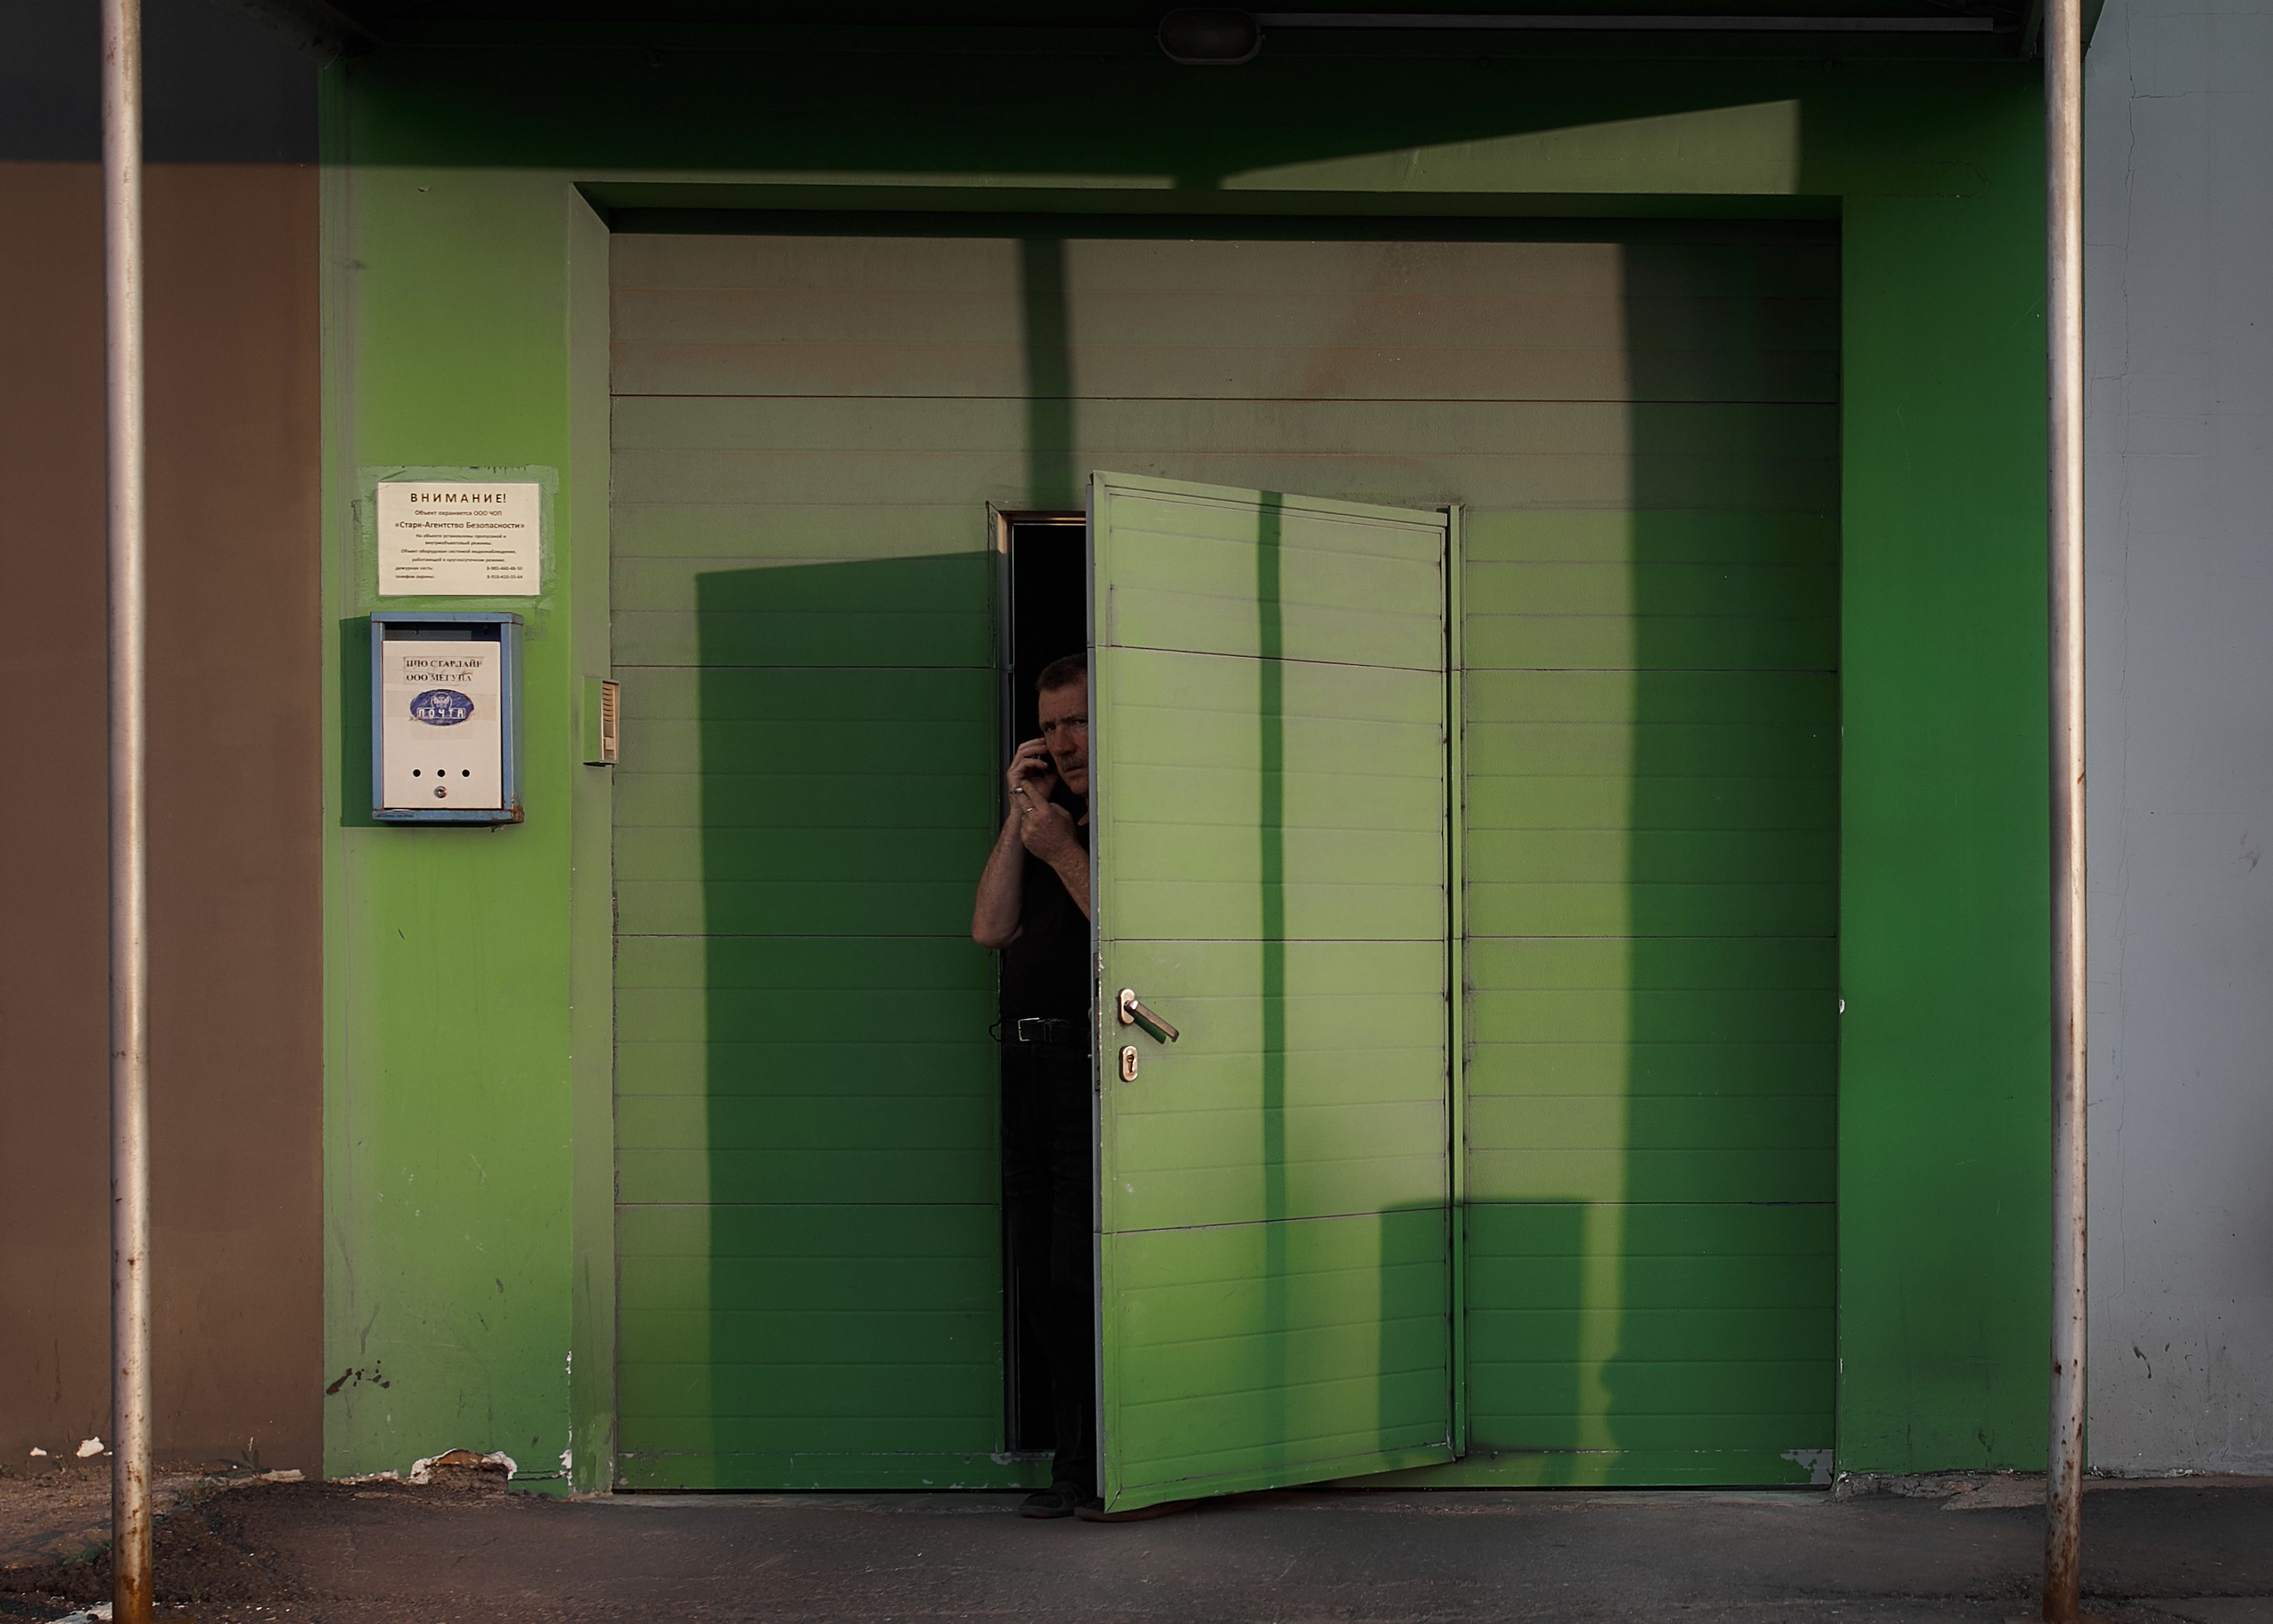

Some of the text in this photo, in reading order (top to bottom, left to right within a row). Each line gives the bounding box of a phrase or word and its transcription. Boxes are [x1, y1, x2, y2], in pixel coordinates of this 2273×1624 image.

[410, 493, 507, 503] ВНИМАНИЕ!
[406, 673, 428, 682] ООО
[418, 709, 464, 718] ПОЧТА
